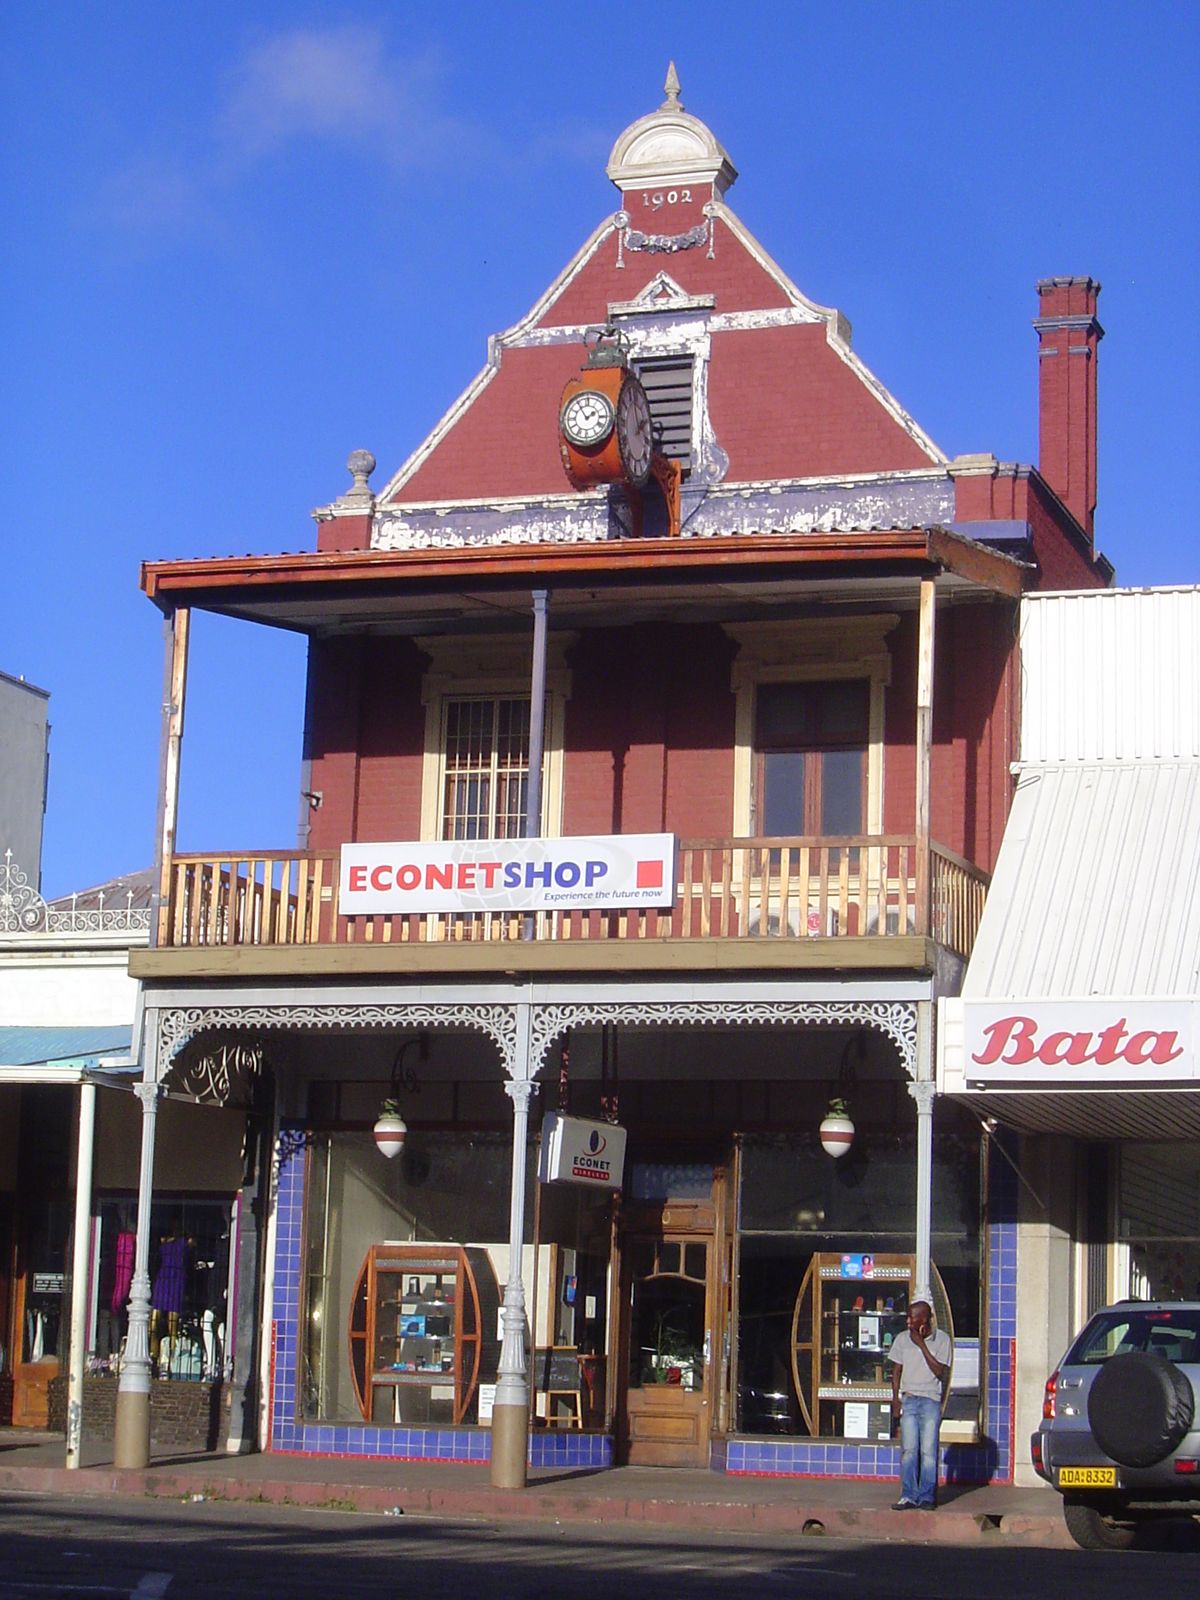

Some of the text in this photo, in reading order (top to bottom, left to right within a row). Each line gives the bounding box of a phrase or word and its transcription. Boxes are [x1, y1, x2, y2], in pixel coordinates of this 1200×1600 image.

[643, 190, 693, 211] 1902
[544, 890, 663, 902] Experience the future now
[971, 1015, 1184, 1066] Bata
[573, 1156, 611, 1170] ECONET
